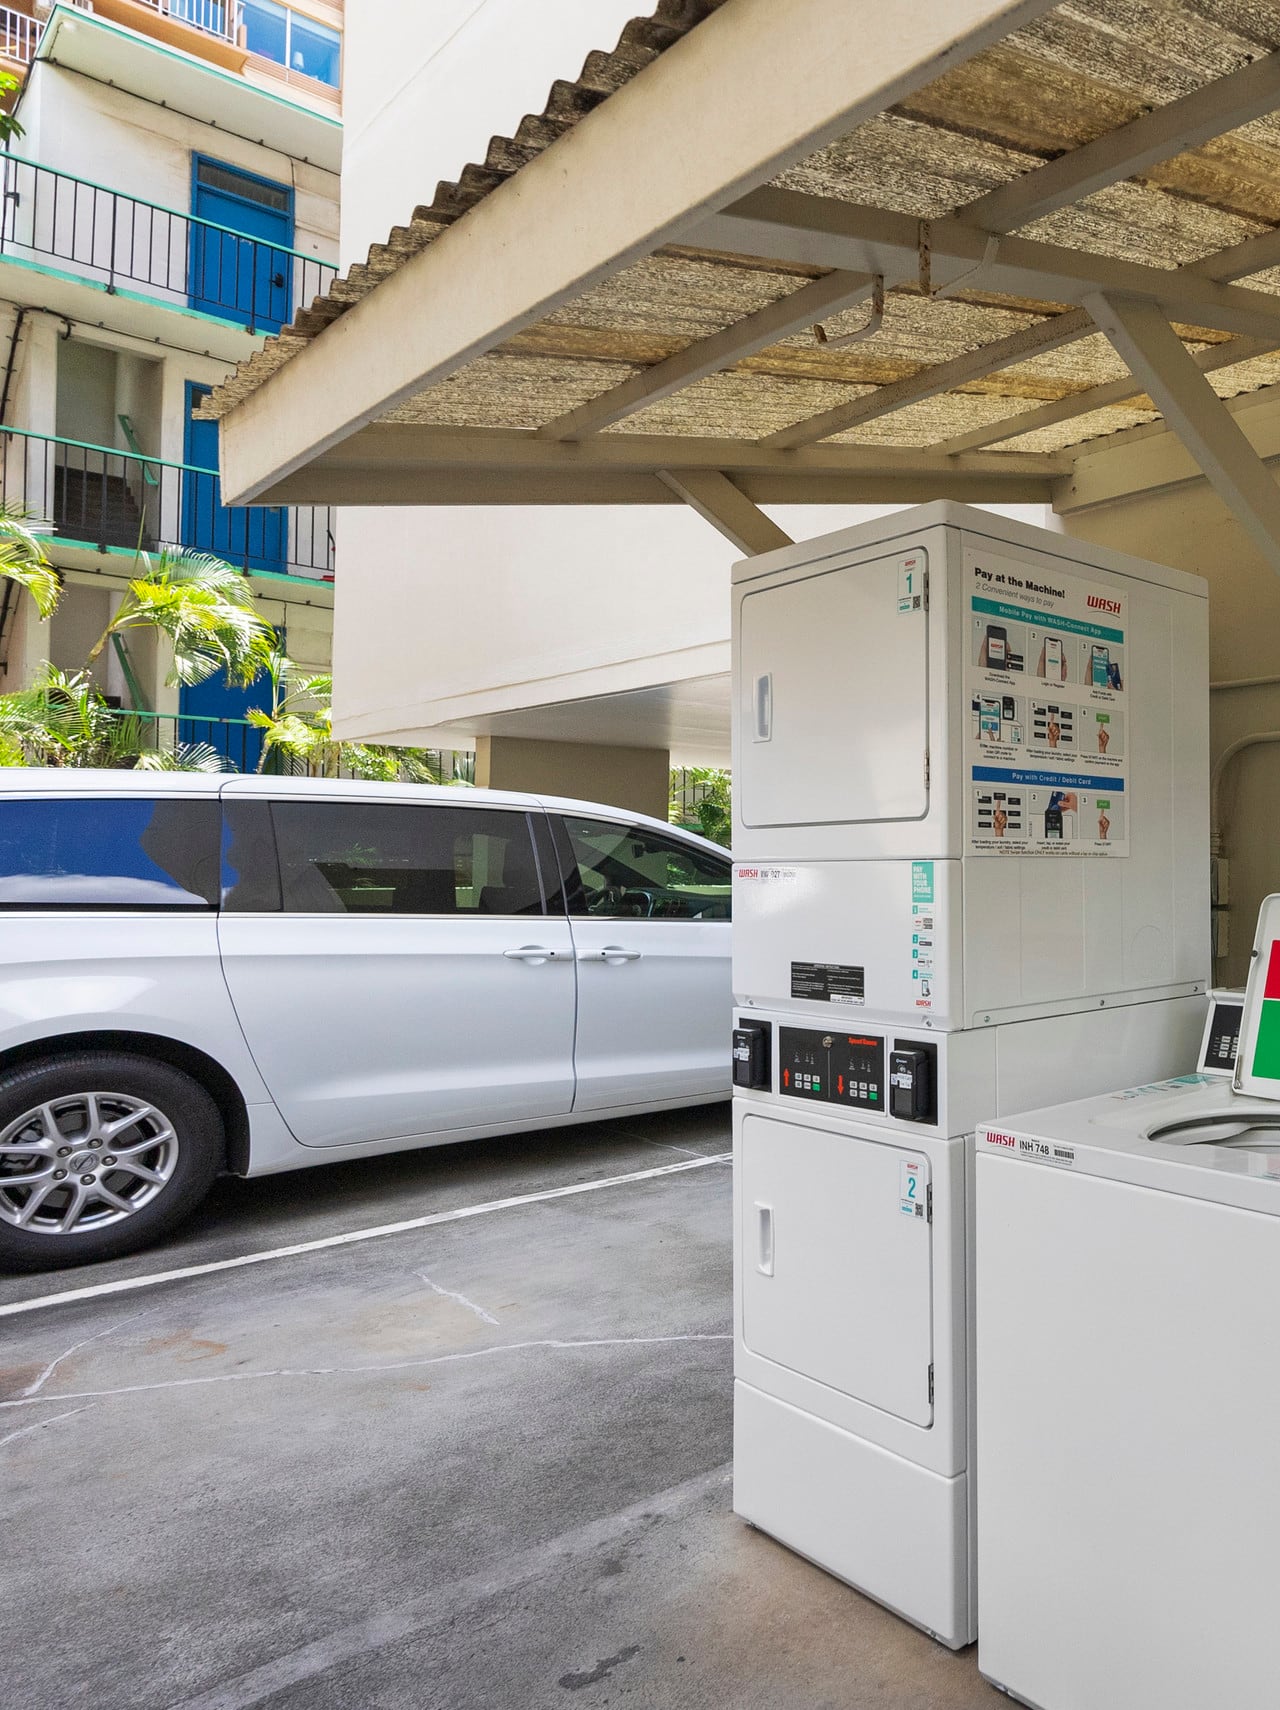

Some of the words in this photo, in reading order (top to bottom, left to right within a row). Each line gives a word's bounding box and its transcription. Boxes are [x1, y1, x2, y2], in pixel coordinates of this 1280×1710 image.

[906, 573, 912, 593] 1
[975, 567, 992, 581] Pay
[996, 574, 1005, 583] at
[1008, 576, 1023, 587] the
[1026, 580, 1065, 598] Machine!
[982, 583, 1018, 598] Convenient
[1018, 593, 1035, 603] ways
[1043, 599, 1055, 609] pay
[1087, 595, 1121, 614] WASH
[999, 606, 1020, 616] Mobile
[1022, 611, 1032, 621] Pay
[1034, 613, 1046, 622] with
[1048, 616, 1089, 633] WASH-Connect
[1091, 627, 1101, 635] App
[1012, 772, 1023, 780] Pay
[1025, 773, 1038, 781] with
[1039, 774, 1057, 783] Credit
[1062, 776, 1077, 784] Debit
[739, 869, 758, 878] WASH
[986, 1132, 1015, 1147] WASH
[1019, 1140, 1034, 1152] INH
[1035, 1143, 1049, 1155] 748
[908, 1177, 916, 1198] 2
